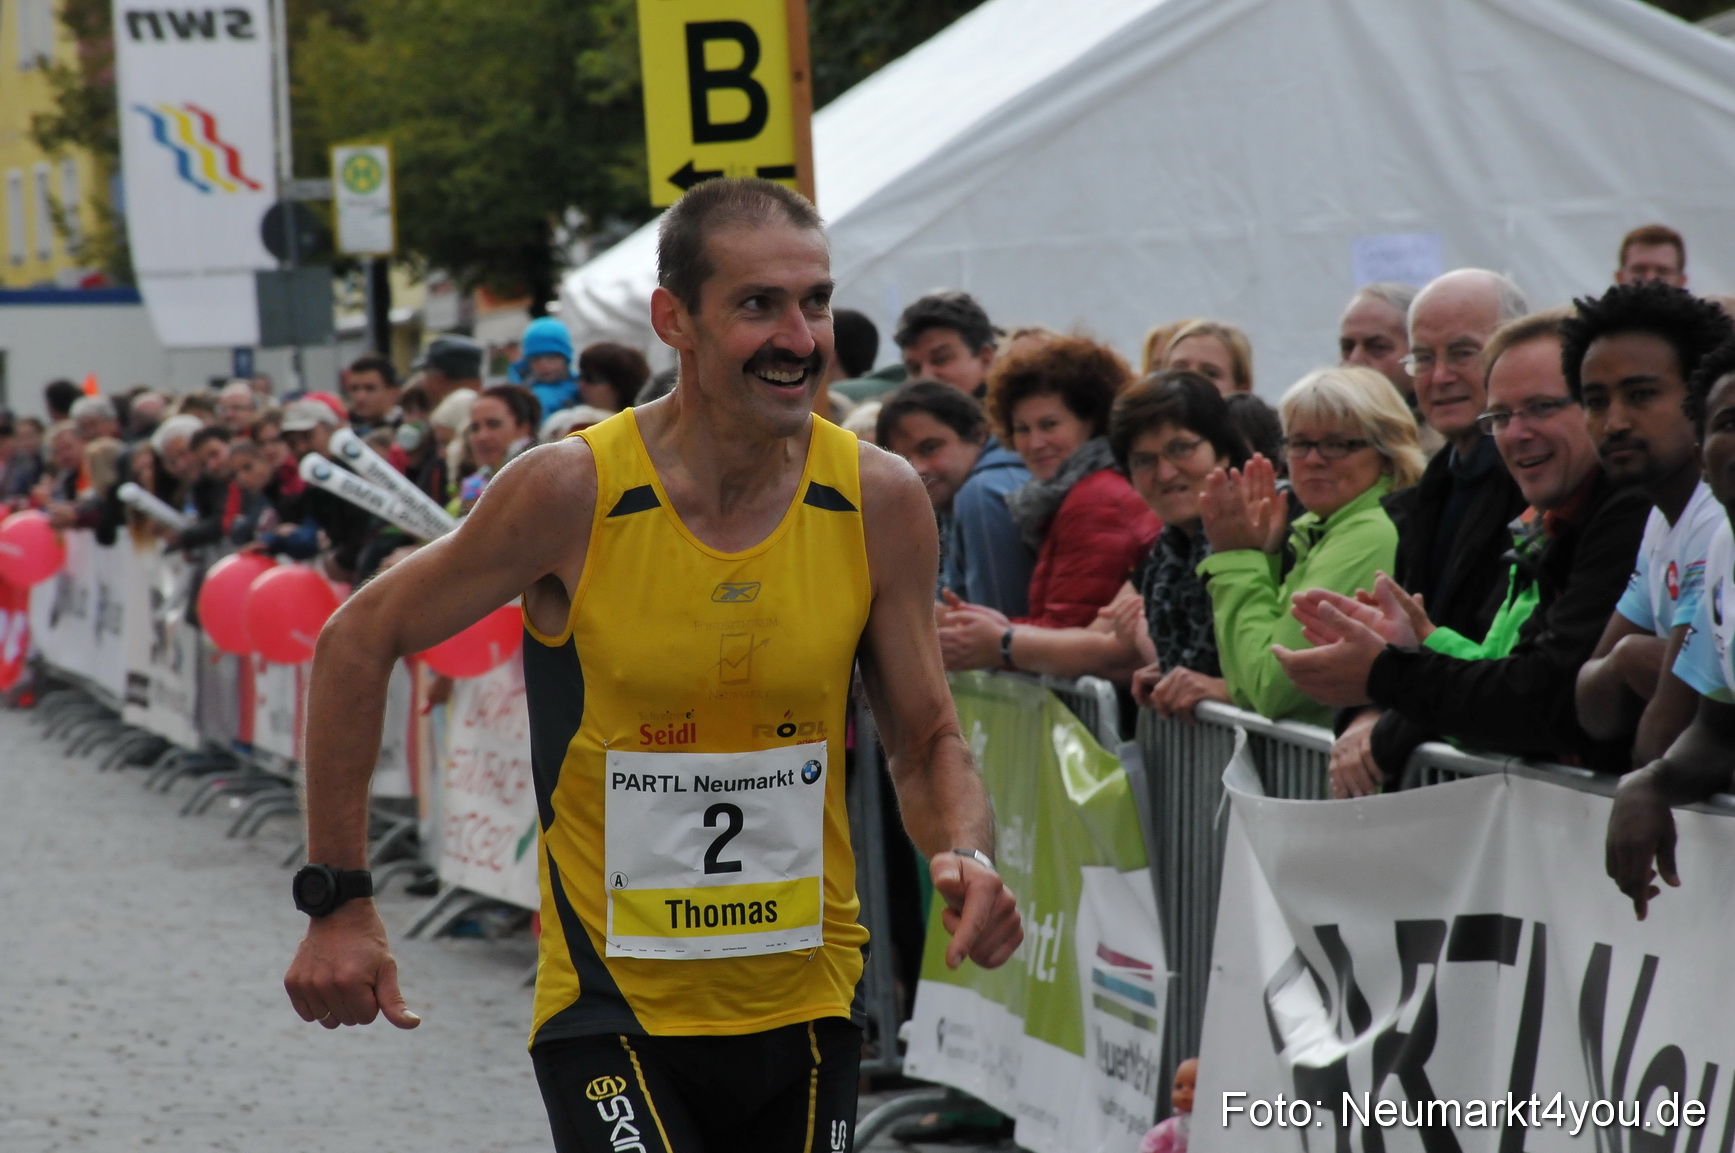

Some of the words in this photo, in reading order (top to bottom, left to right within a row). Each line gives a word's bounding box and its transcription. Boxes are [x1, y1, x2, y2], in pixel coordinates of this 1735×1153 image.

[685, 19, 770, 145] B
[640, 722, 697, 746] Seidl
[612, 772, 687, 793] PARTL
[693, 769, 795, 793] Neumarkt
[703, 802, 744, 875] 2
[614, 874, 624, 888] A
[665, 899, 778, 929] Thomas
